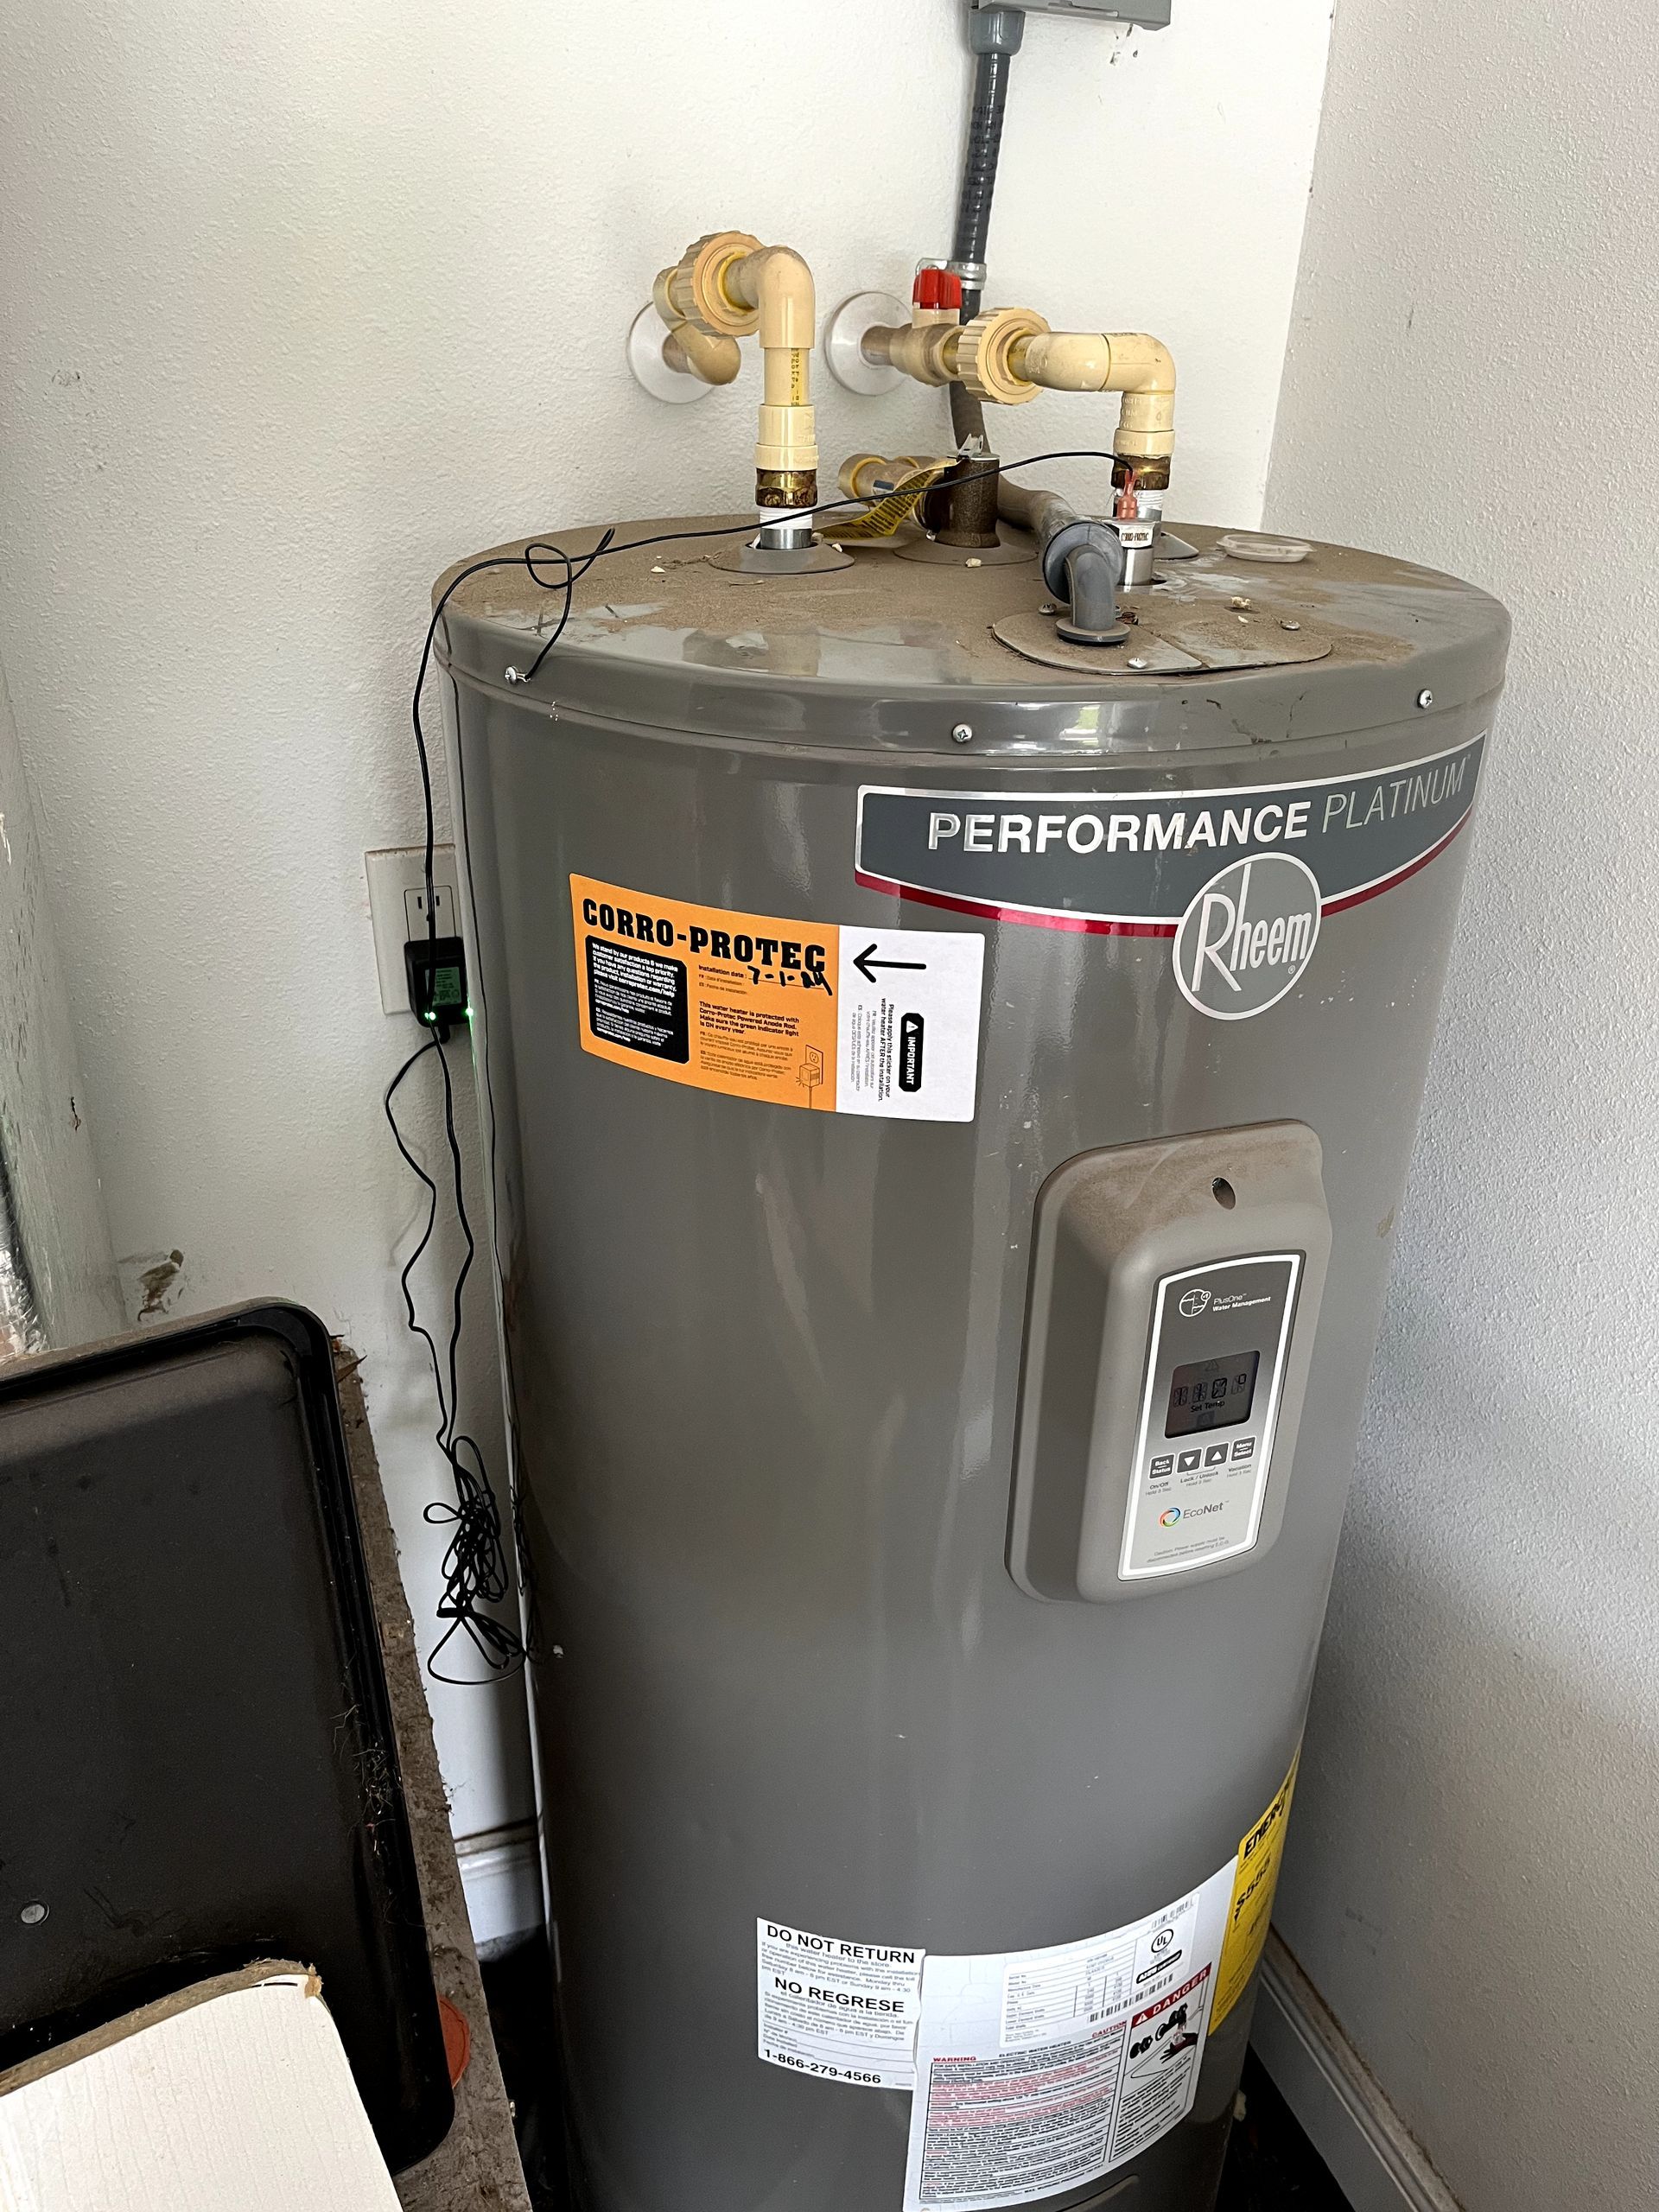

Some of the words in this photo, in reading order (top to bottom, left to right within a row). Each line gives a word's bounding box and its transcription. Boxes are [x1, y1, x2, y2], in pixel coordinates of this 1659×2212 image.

[928, 801, 1312, 854] PERFORMANCE
[1322, 754, 1468, 833] PLATINUM
[582, 898, 825, 972] CORRO-PROTEC
[1192, 862, 1312, 993] Rheem
[699, 965, 729, 975] Installation
[700, 1007, 735, 1020] Corro-Protec
[737, 1015, 762, 1024] Powered
[906, 1036, 917, 1085] IMPORTANT
[1214, 1294, 1243, 1305] PlusOne
[1232, 1297, 1271, 1307] Management
[1191, 1404, 1203, 1413] Set
[1205, 1401, 1225, 1409] Temp
[1183, 1502, 1224, 1519] EcoNet
[767, 1925, 791, 1942] DO
[798, 1935, 834, 1952] NOT
[841, 1944, 914, 1962] RETURN
[1157, 1936, 1167, 1946] UL
[823, 1952, 845, 1961] heater
[775, 1977, 802, 1993] NO
[809, 1987, 904, 2012] REGRESE
[1154, 1970, 1206, 2014] DANGER
[1092, 2020, 1127, 2038] CAUTION
[765, 2049, 881, 2083] 1-866-279-4566
